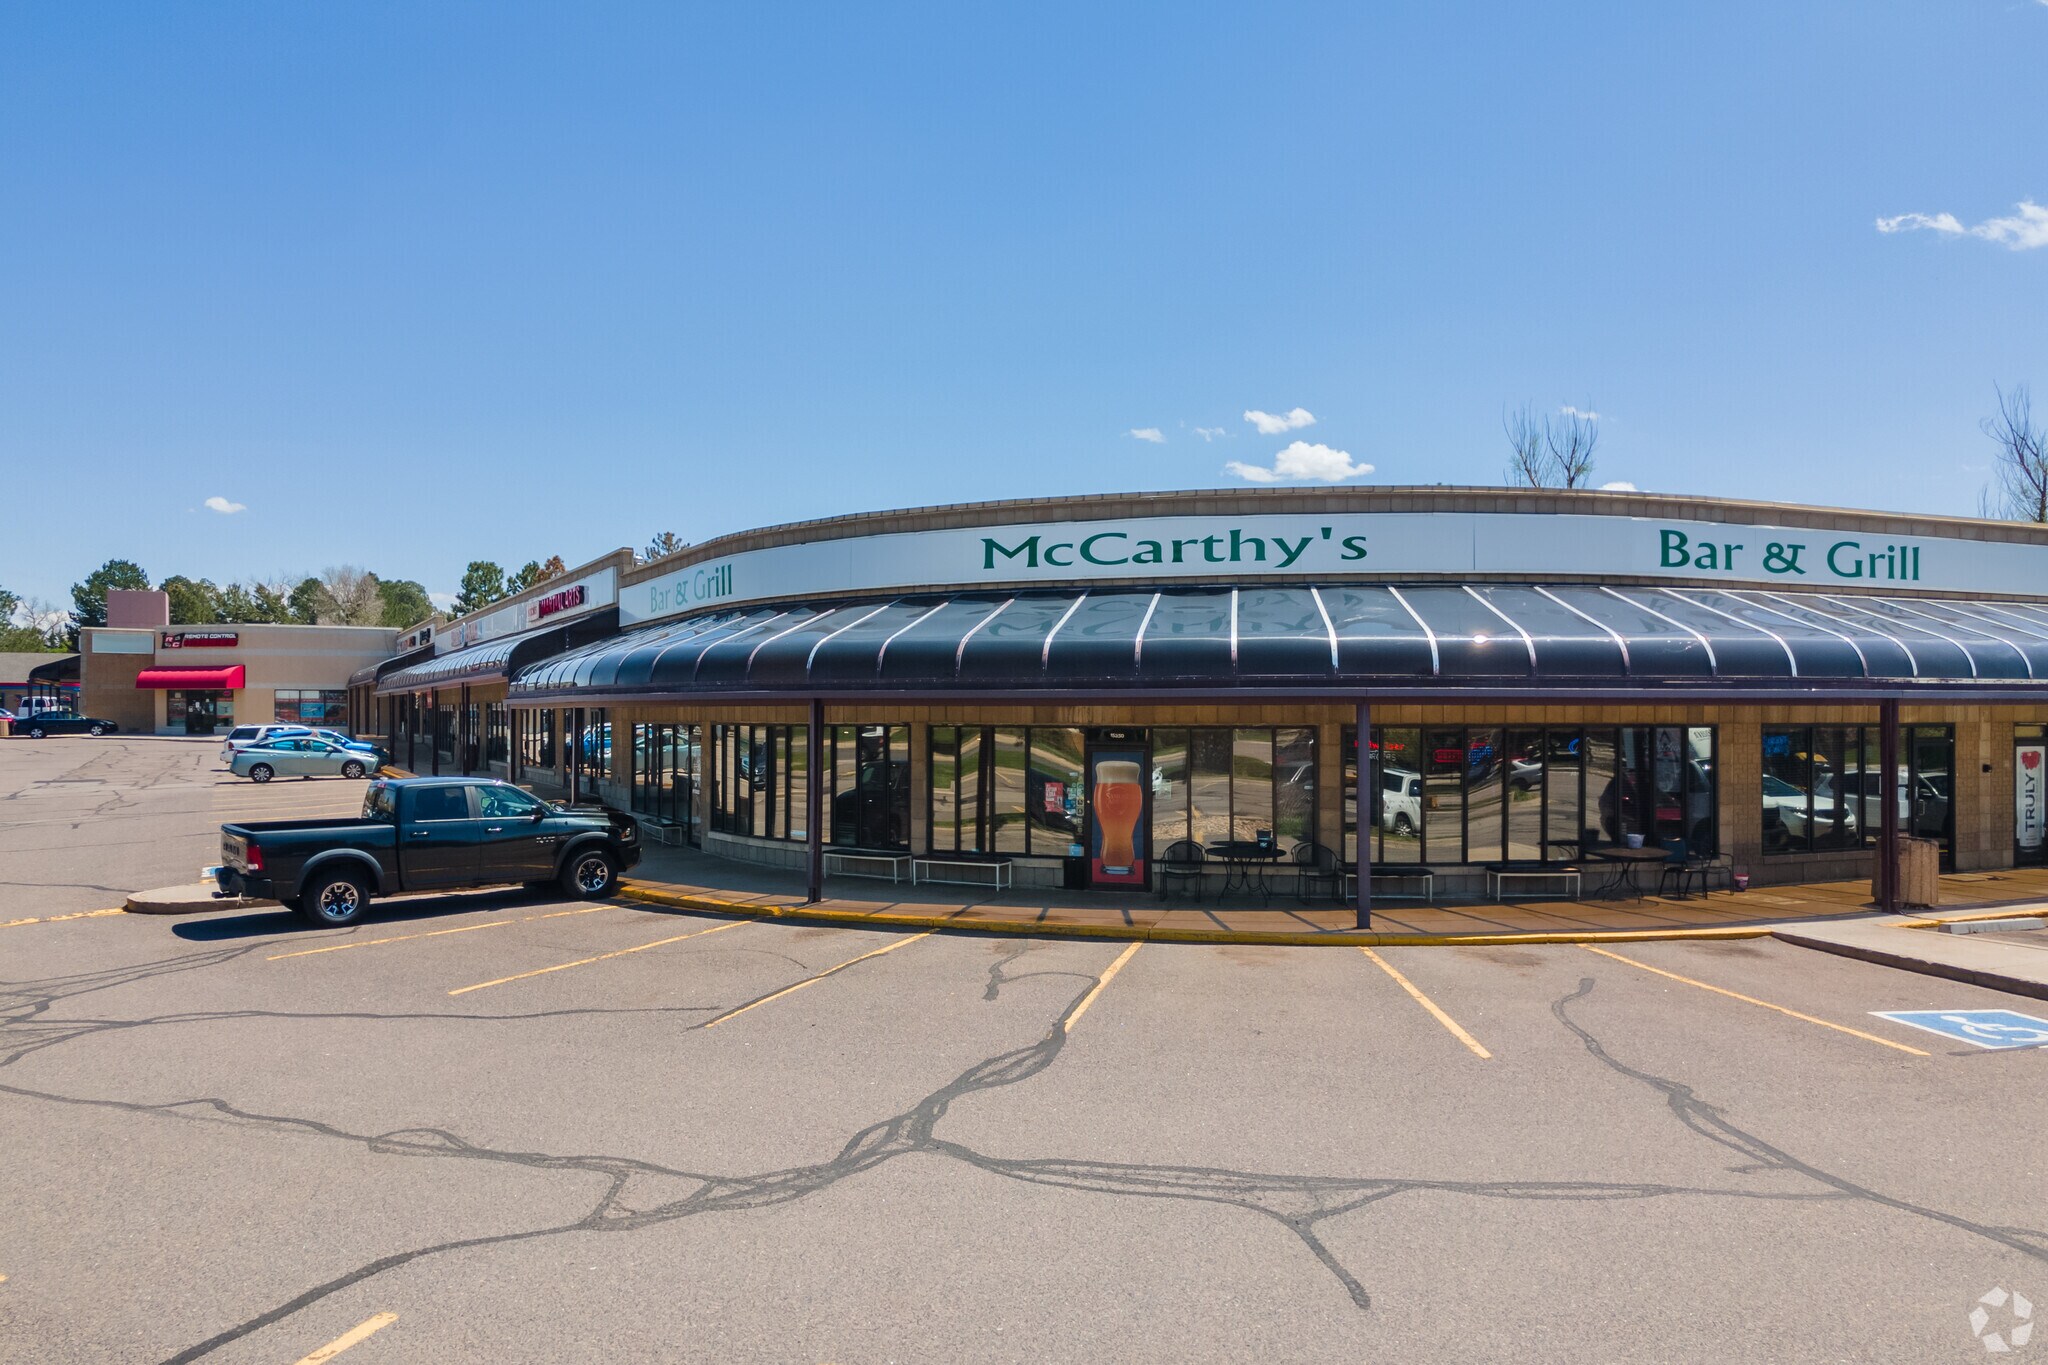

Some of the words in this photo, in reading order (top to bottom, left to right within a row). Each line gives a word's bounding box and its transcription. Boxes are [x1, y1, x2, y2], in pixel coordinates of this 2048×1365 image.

[980, 526, 1368, 569] McCarthy's
[1659, 529, 1744, 571] Bar
[1762, 542, 1807, 575] &
[1826, 541, 1920, 581] Grill
[564, 585, 584, 609] ARTS
[650, 586, 671, 613] Bar
[675, 580, 689, 606] &
[693, 563, 733, 600] Grill
[2025, 773, 2036, 832] TRULY
